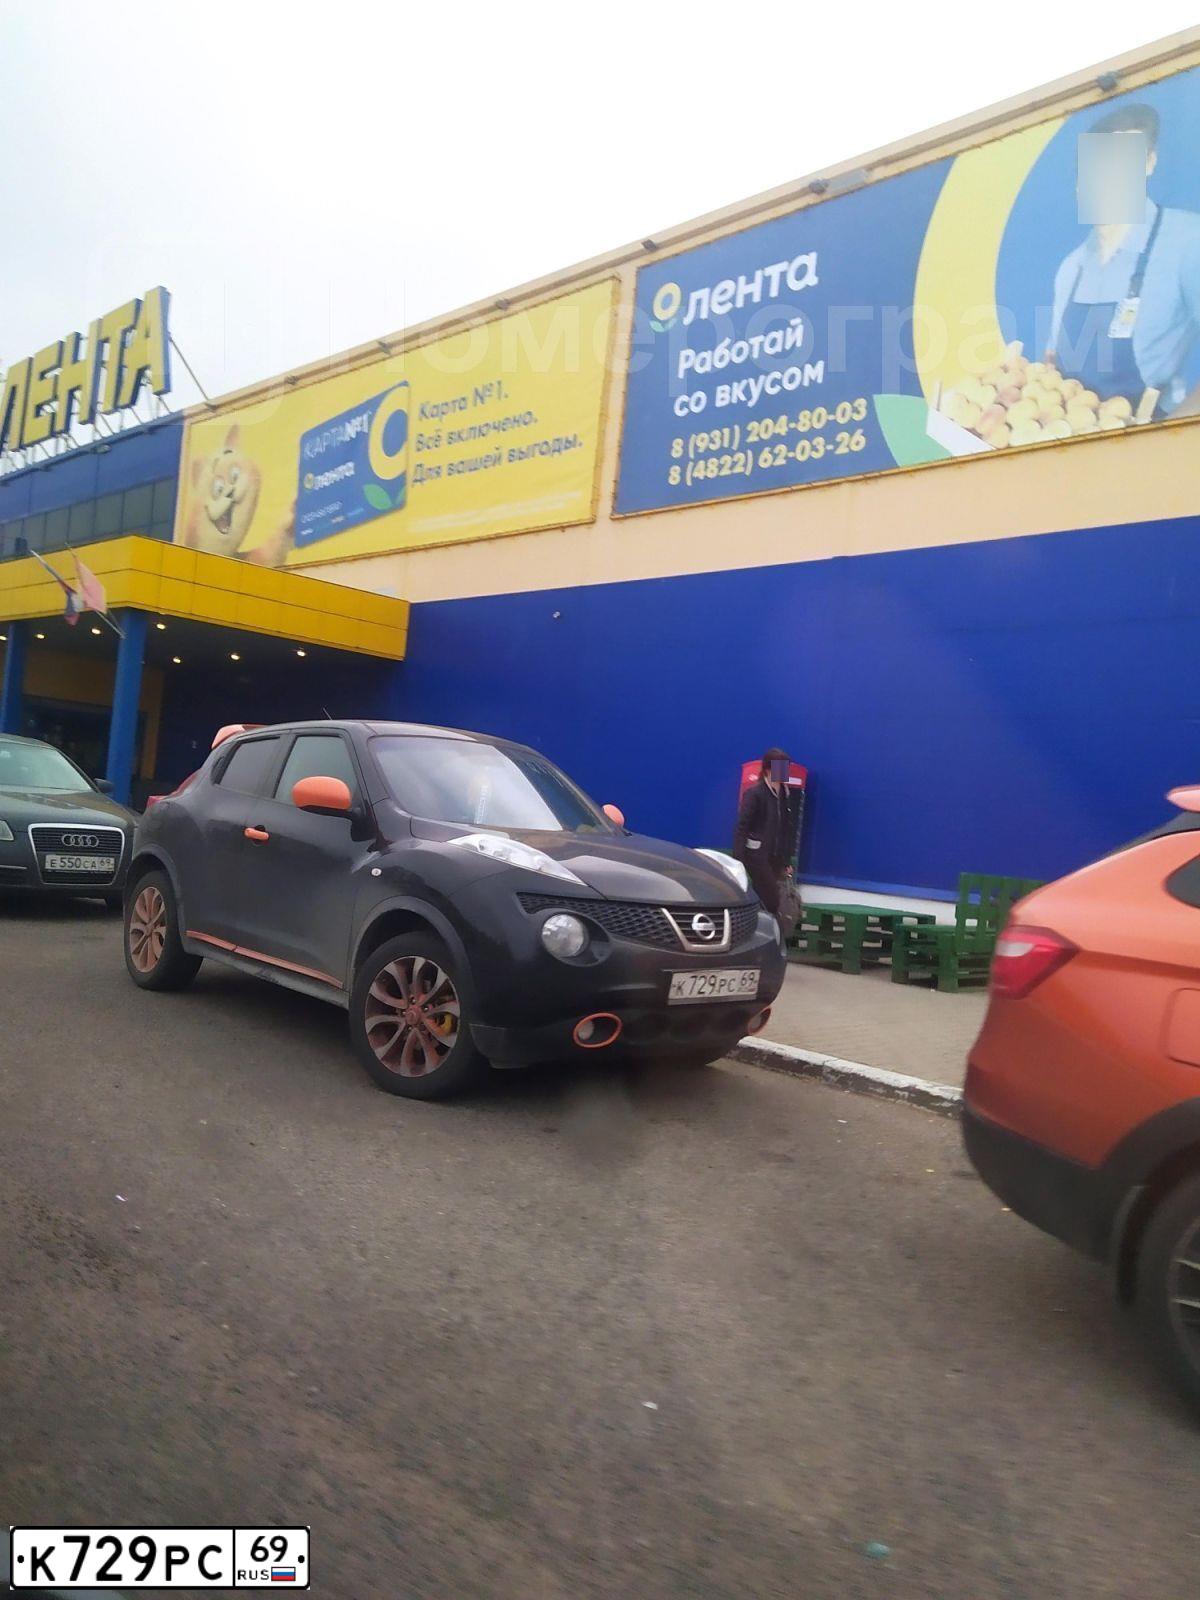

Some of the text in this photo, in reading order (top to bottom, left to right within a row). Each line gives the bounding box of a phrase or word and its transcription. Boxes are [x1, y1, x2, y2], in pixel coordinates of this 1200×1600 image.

[683, 251, 819, 326] лента
[678, 318, 804, 379] Работай
[418, 393, 468, 421] Карта
[674, 360, 825, 417] со вкусом
[415, 410, 538, 452] Всё включено.
[671, 398, 868, 459] 8 (931) 204-80-03
[411, 434, 583, 485] Для вашей выгоды.
[668, 429, 867, 486] 8 (4822) 62-03-26
[675, 972, 756, 997] К729РС 69
